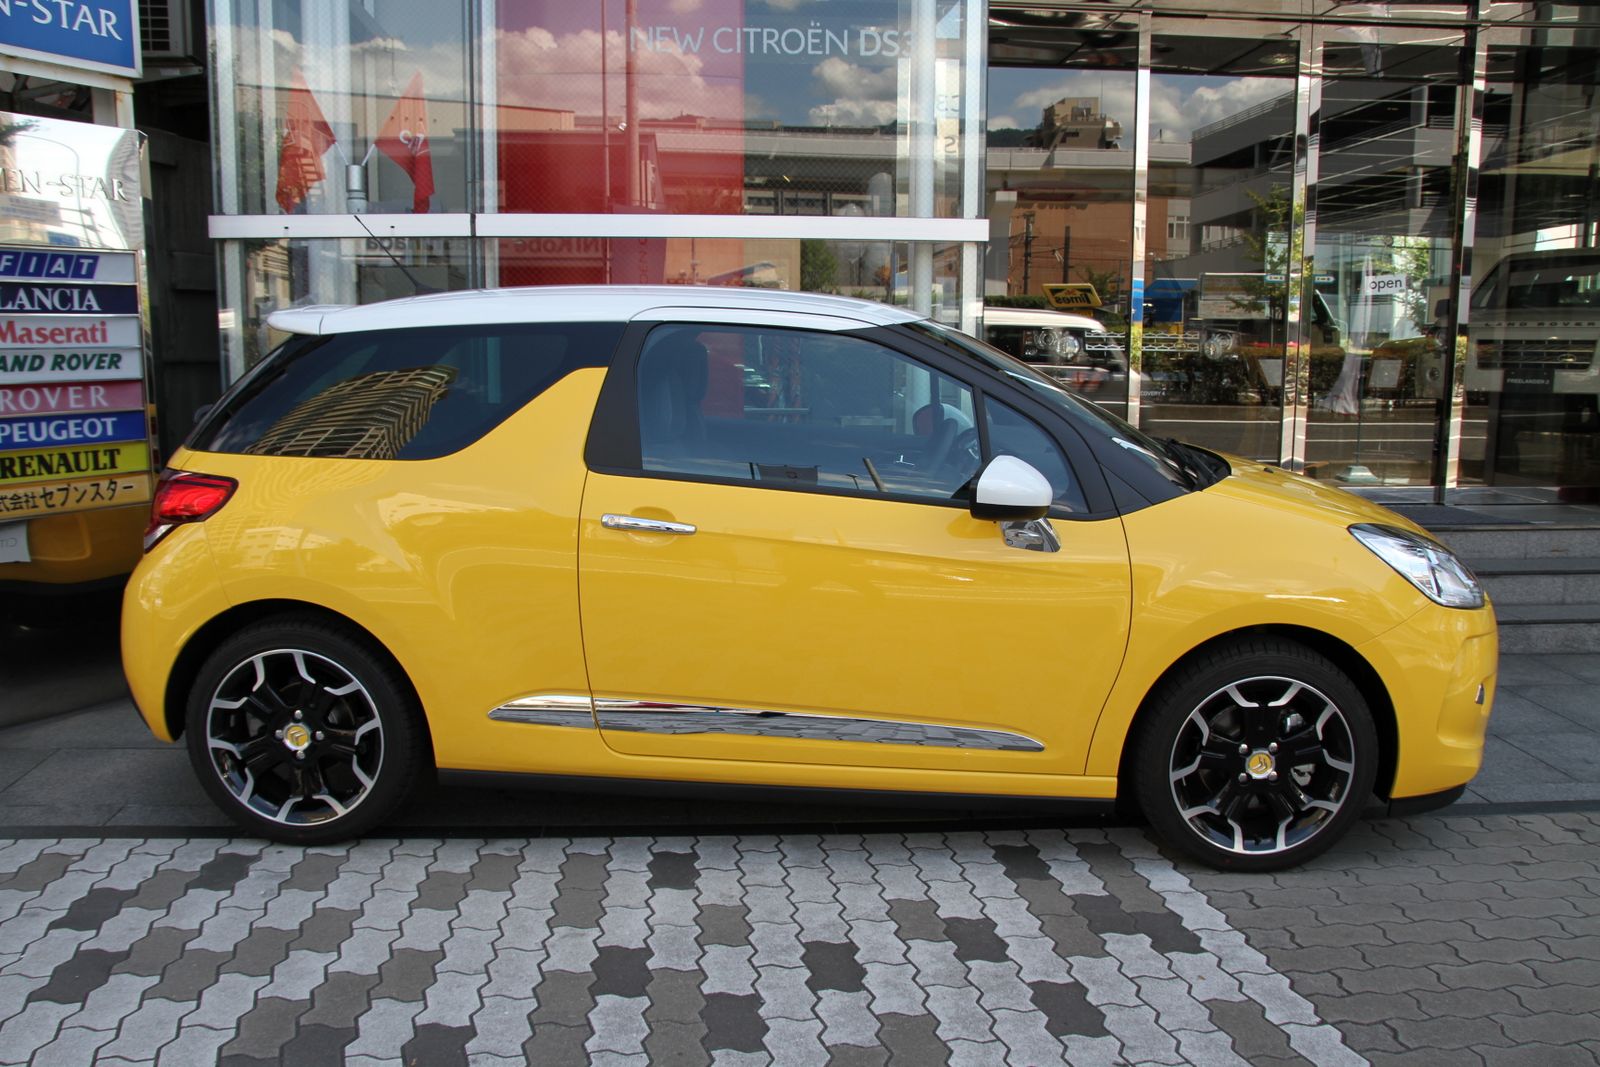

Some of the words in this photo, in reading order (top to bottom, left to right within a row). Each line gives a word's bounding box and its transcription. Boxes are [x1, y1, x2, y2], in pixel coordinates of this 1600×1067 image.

[630, 26, 704, 53] NEW
[712, 20, 849, 55] CITROËN
[0, 255, 94, 275] FIAT
[1369, 279, 1403, 293] open
[0, 287, 102, 311] LANCIA
[0, 320, 109, 344] Maserati
[51, 353, 122, 371] ROVER
[0, 385, 109, 412] ROVER
[0, 417, 117, 443] PEUGEOT
[0, 448, 121, 479] RENAULT
